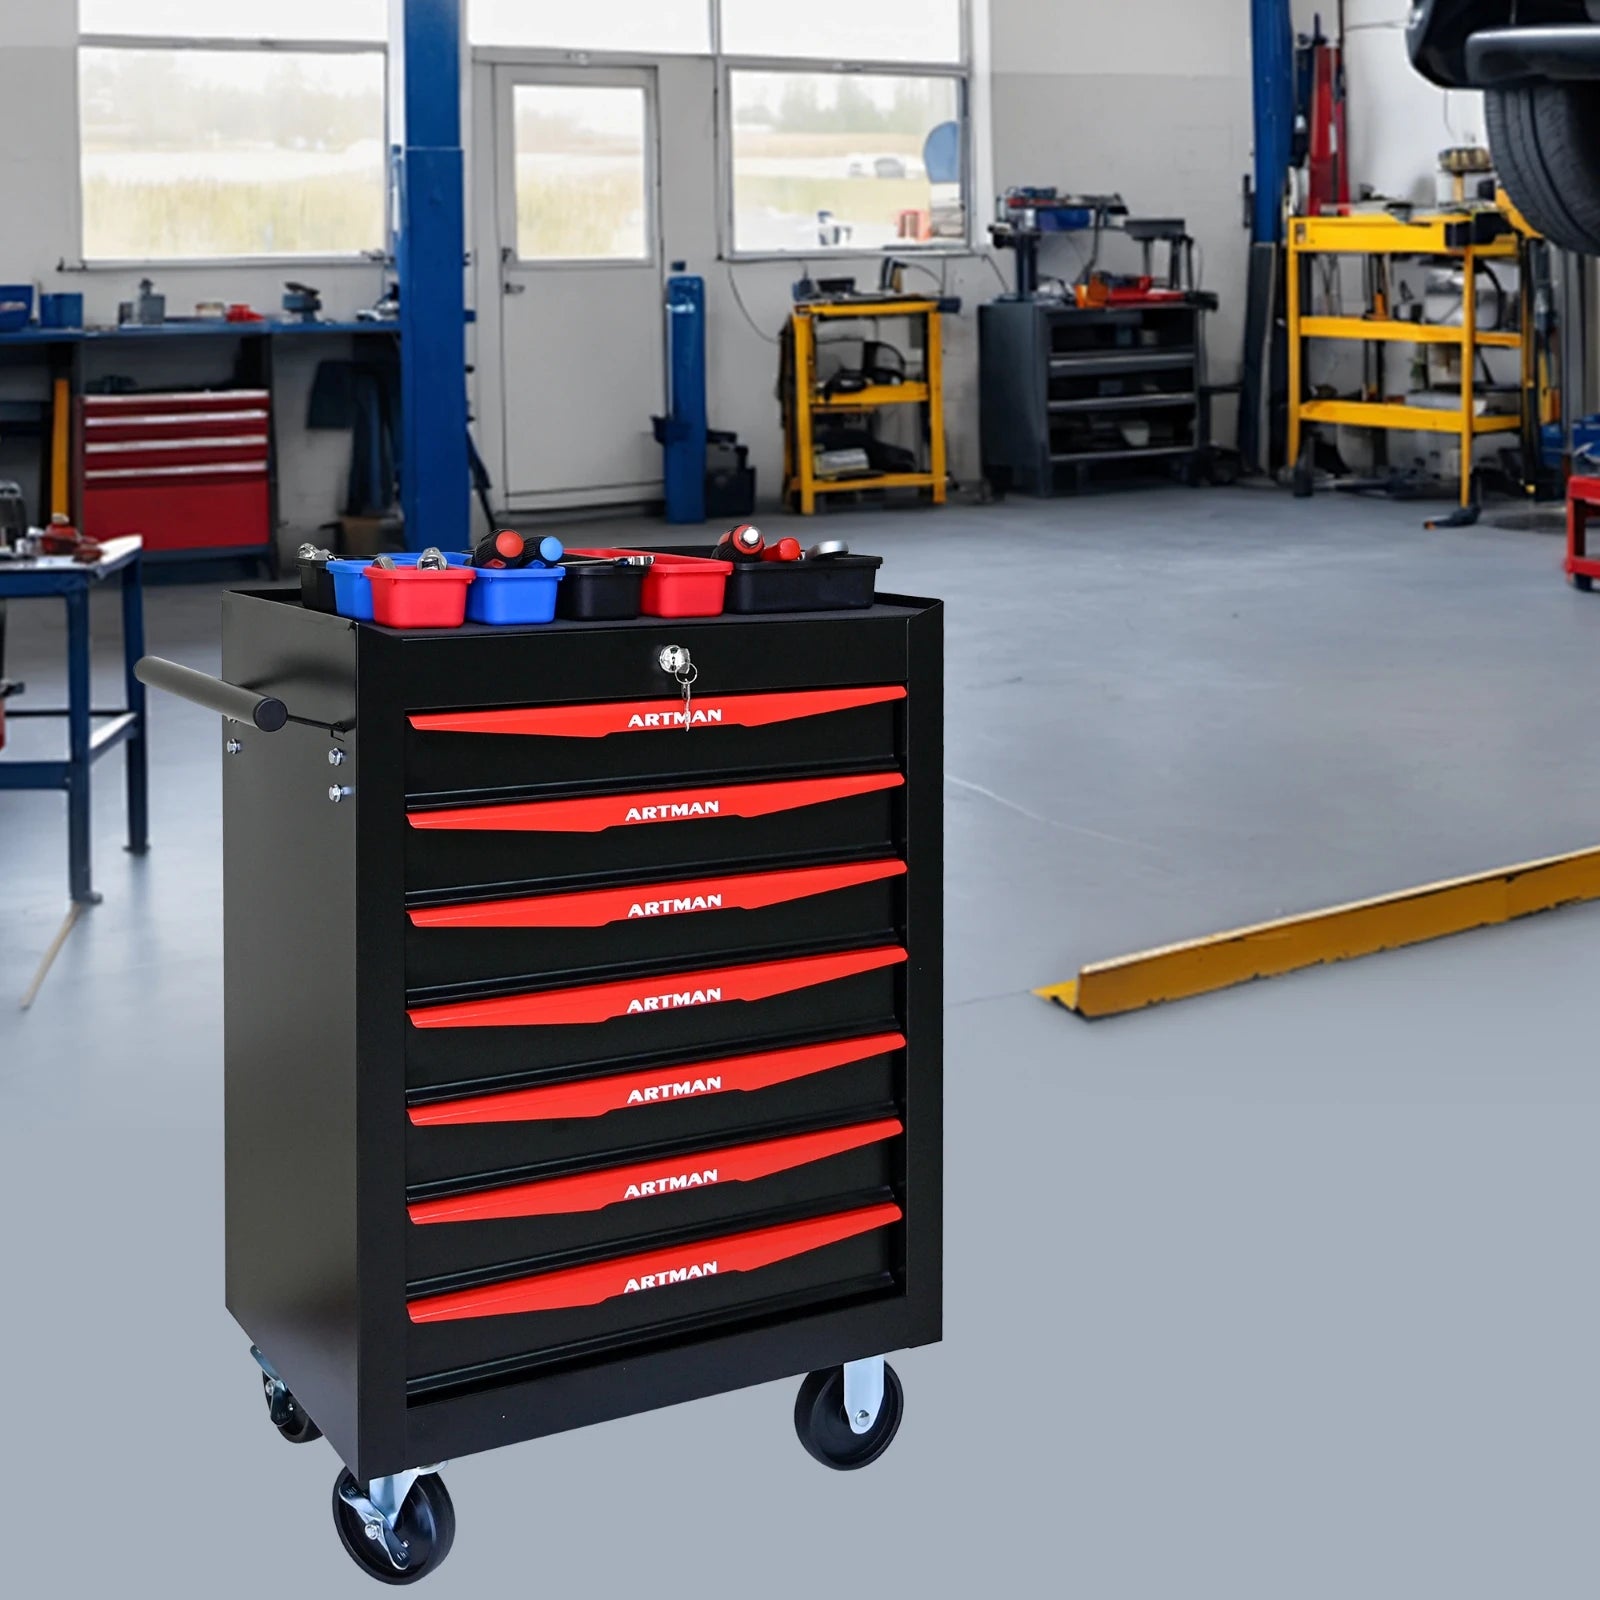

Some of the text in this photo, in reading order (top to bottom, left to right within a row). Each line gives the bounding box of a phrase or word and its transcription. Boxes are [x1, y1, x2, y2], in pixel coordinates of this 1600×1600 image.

[628, 709, 722, 728] ARTMAN
[625, 801, 719, 821] ARTMAN
[627, 894, 722, 918] ARTMAN
[626, 988, 721, 1014] ARTMAN
[627, 1076, 721, 1104] ARTMAN
[624, 1169, 718, 1198] ARTMAN
[624, 1261, 718, 1293] ARTMAN
